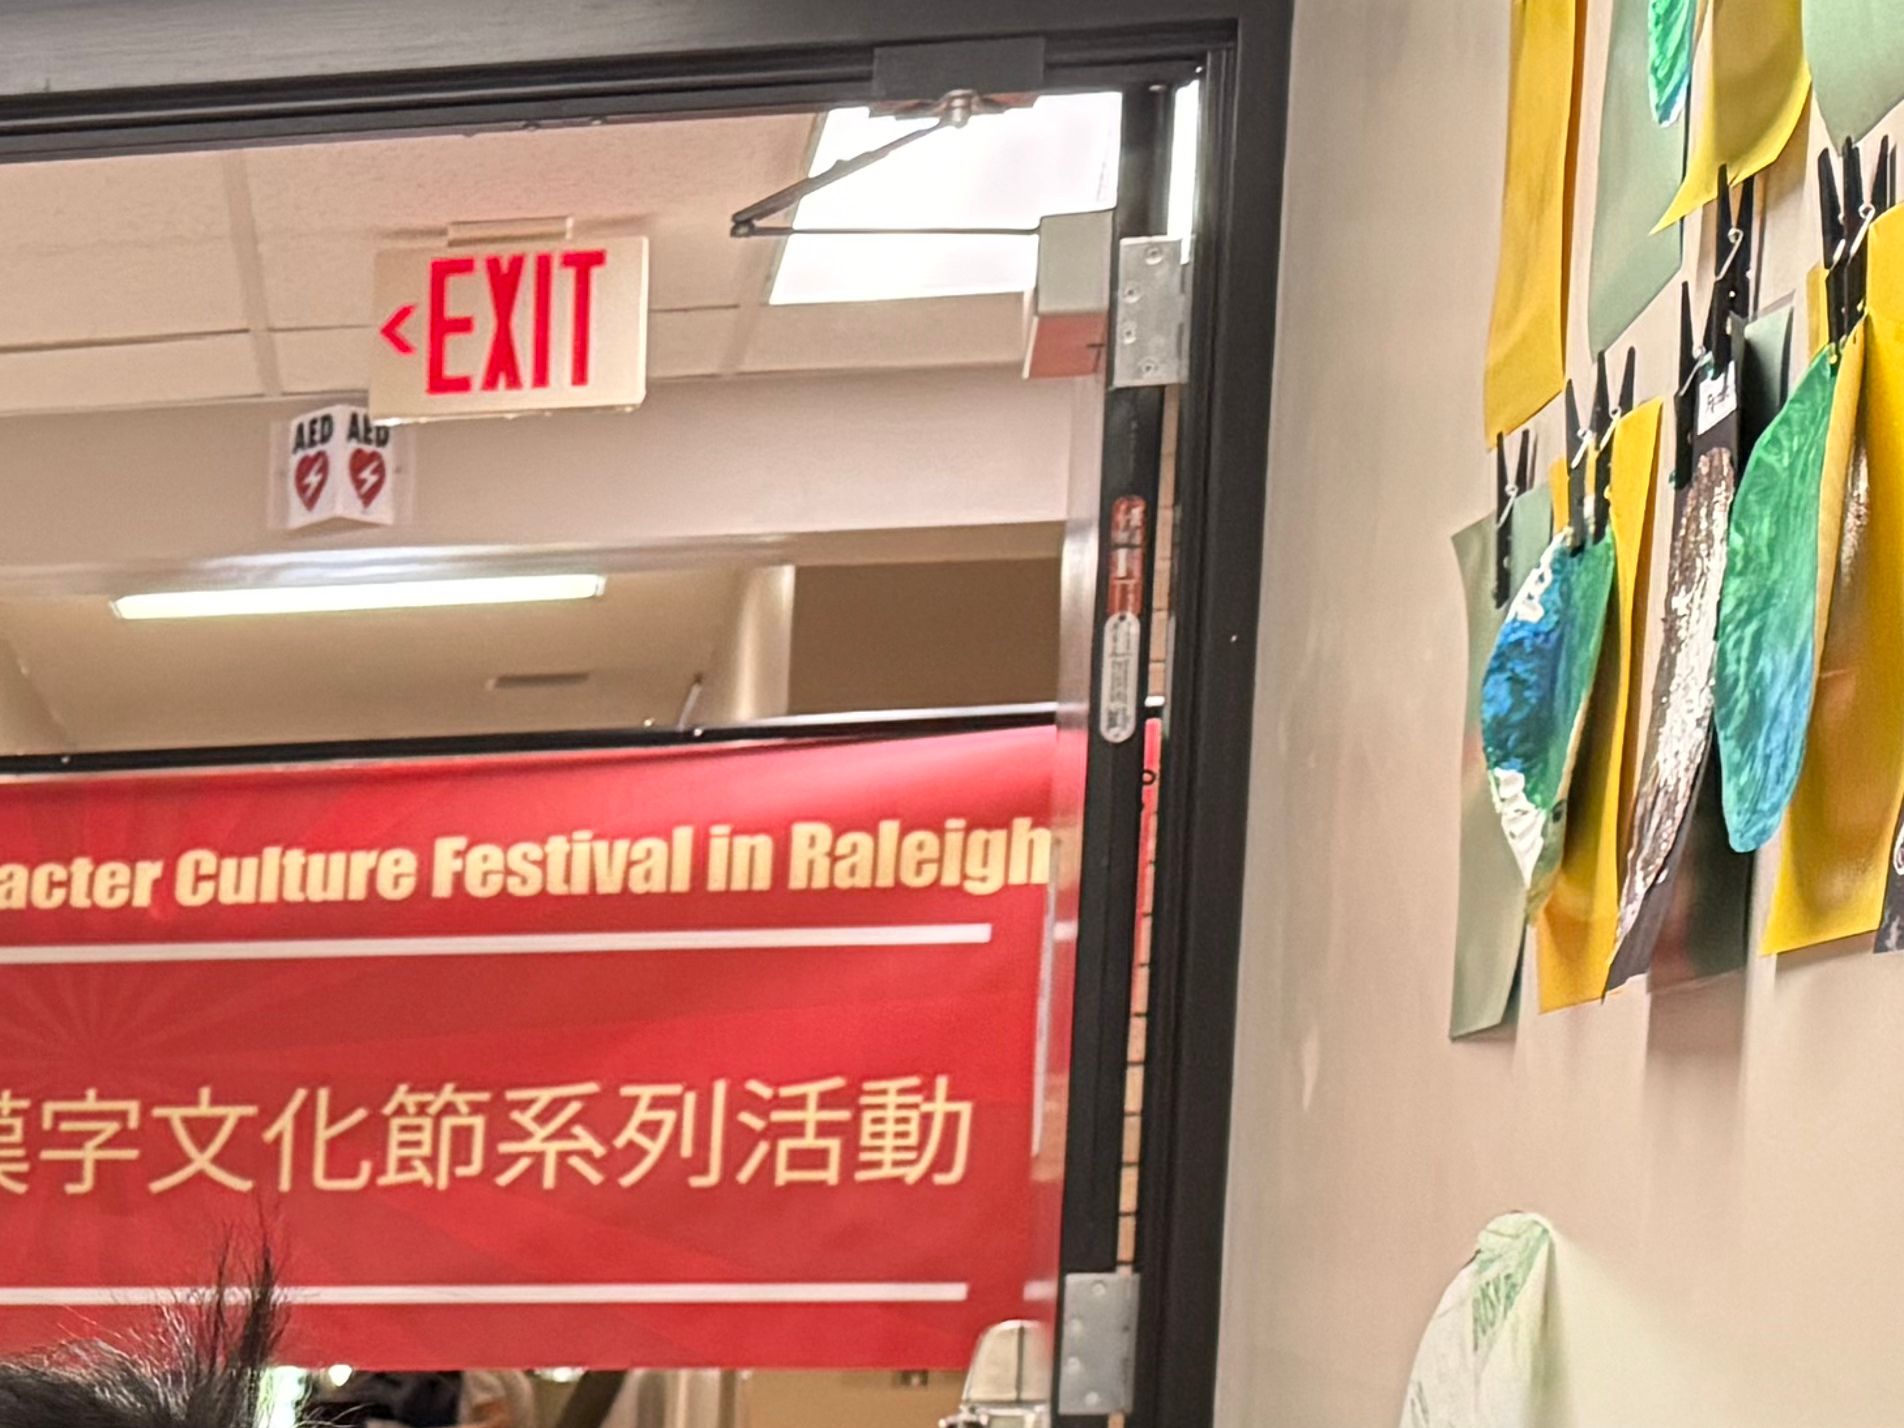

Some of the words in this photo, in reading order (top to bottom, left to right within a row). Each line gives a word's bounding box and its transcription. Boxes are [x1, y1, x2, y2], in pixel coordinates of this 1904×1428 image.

[426, 250, 607, 396] EXIT
[293, 413, 334, 454] AED
[346, 412, 390, 449] AED
[175, 845, 416, 908] Culture
[433, 824, 694, 900] Festival
[708, 824, 769, 891] in
[788, 817, 1053, 897] Raleigh
